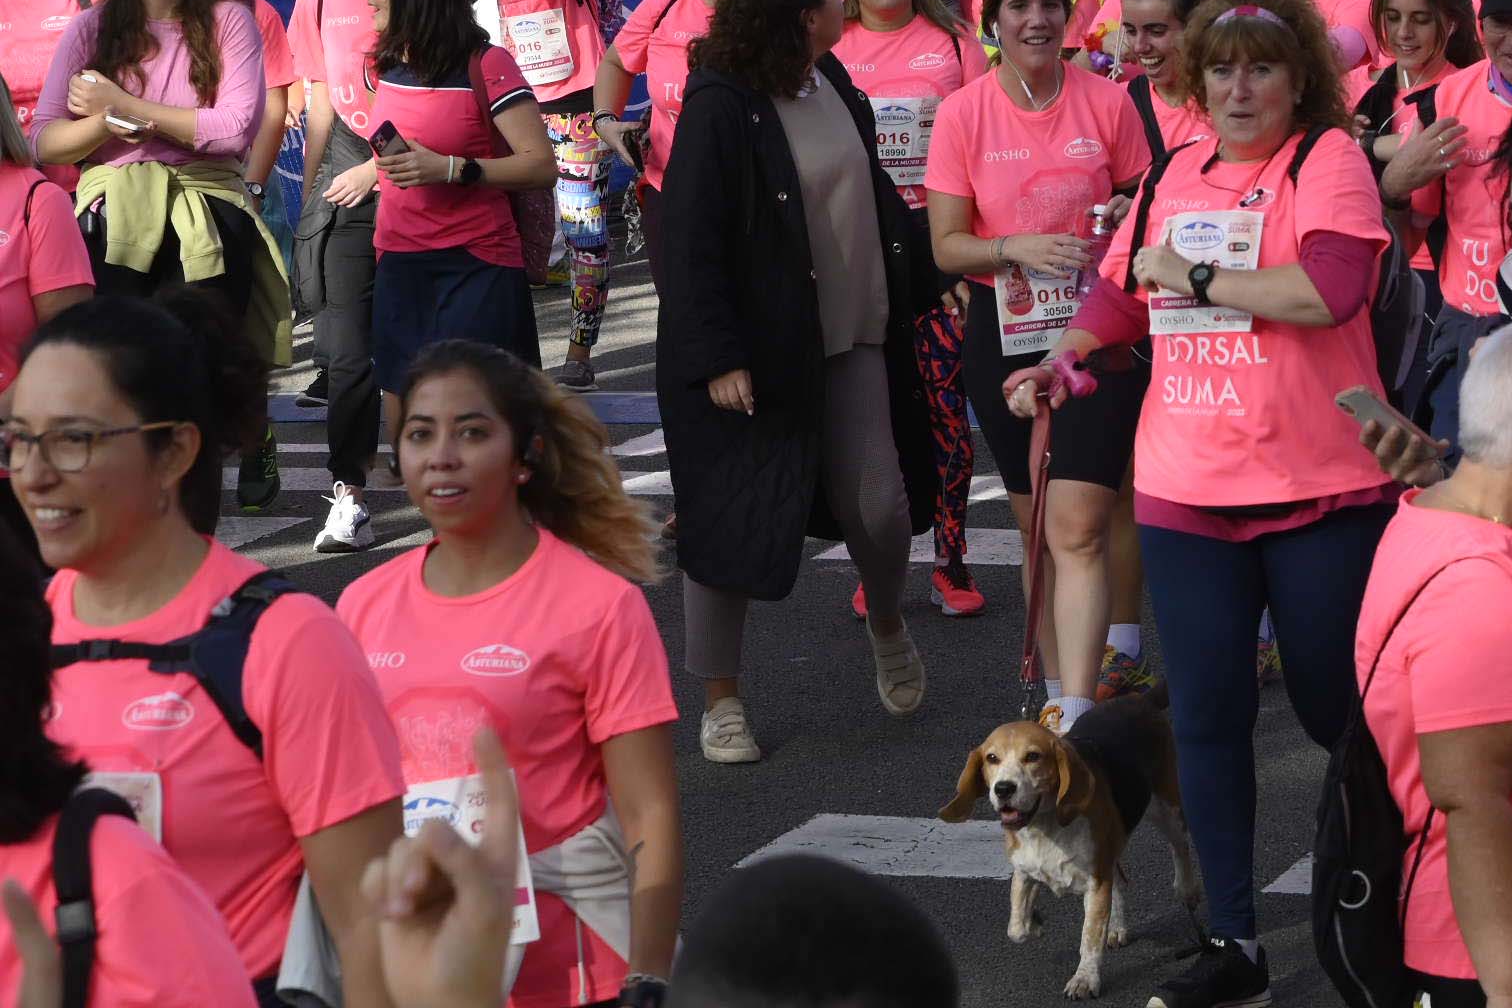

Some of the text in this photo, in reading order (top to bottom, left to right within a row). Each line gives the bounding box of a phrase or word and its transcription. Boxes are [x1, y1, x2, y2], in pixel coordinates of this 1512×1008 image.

[519, 41, 542, 53] 016
[876, 132, 910, 145] 016
[880, 148, 907, 157] 18990
[984, 148, 1030, 162] OYSHO
[1161, 198, 1209, 210] OYSHO
[1462, 238, 1489, 267] TU
[1037, 286, 1076, 304] 016
[1043, 304, 1074, 318] 30508
[1014, 321, 1045, 332] CARRERA
[1159, 316, 1195, 326] OYSHO
[1013, 334, 1048, 348] OYSHO
[1166, 335, 1269, 365] DORSAL
[1162, 374, 1242, 405] SUMA
[466, 655, 524, 669] ASTURIANA
